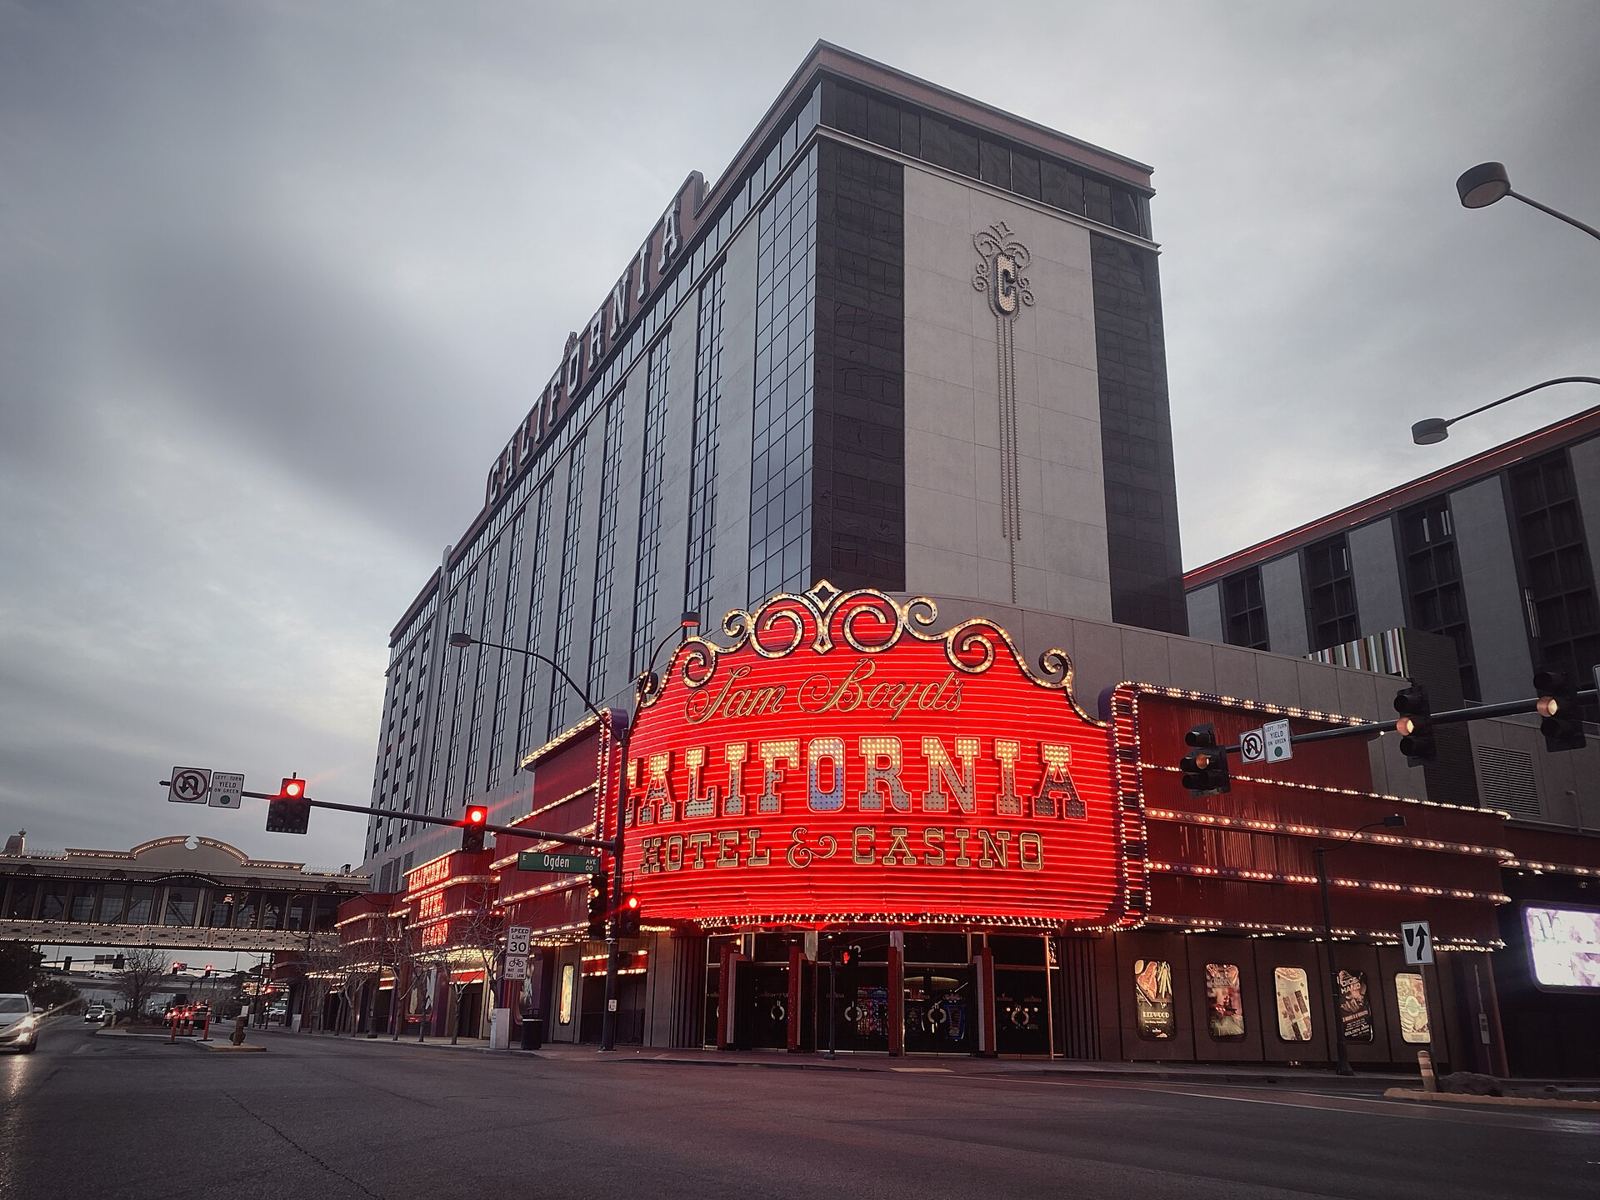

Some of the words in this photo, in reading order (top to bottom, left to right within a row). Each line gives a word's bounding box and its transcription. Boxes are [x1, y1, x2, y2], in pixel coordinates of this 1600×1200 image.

[993, 252, 1017, 313] C
[489, 199, 683, 505] CALIFORNIA
[685, 665, 787, 725] Sam
[798, 658, 963, 721] Boyd's
[543, 855, 570, 870] Ogden
[640, 829, 770, 873] HOTEL
[787, 827, 837, 869] &
[853, 827, 1044, 871] CASINO
[510, 941, 527, 952] 30
